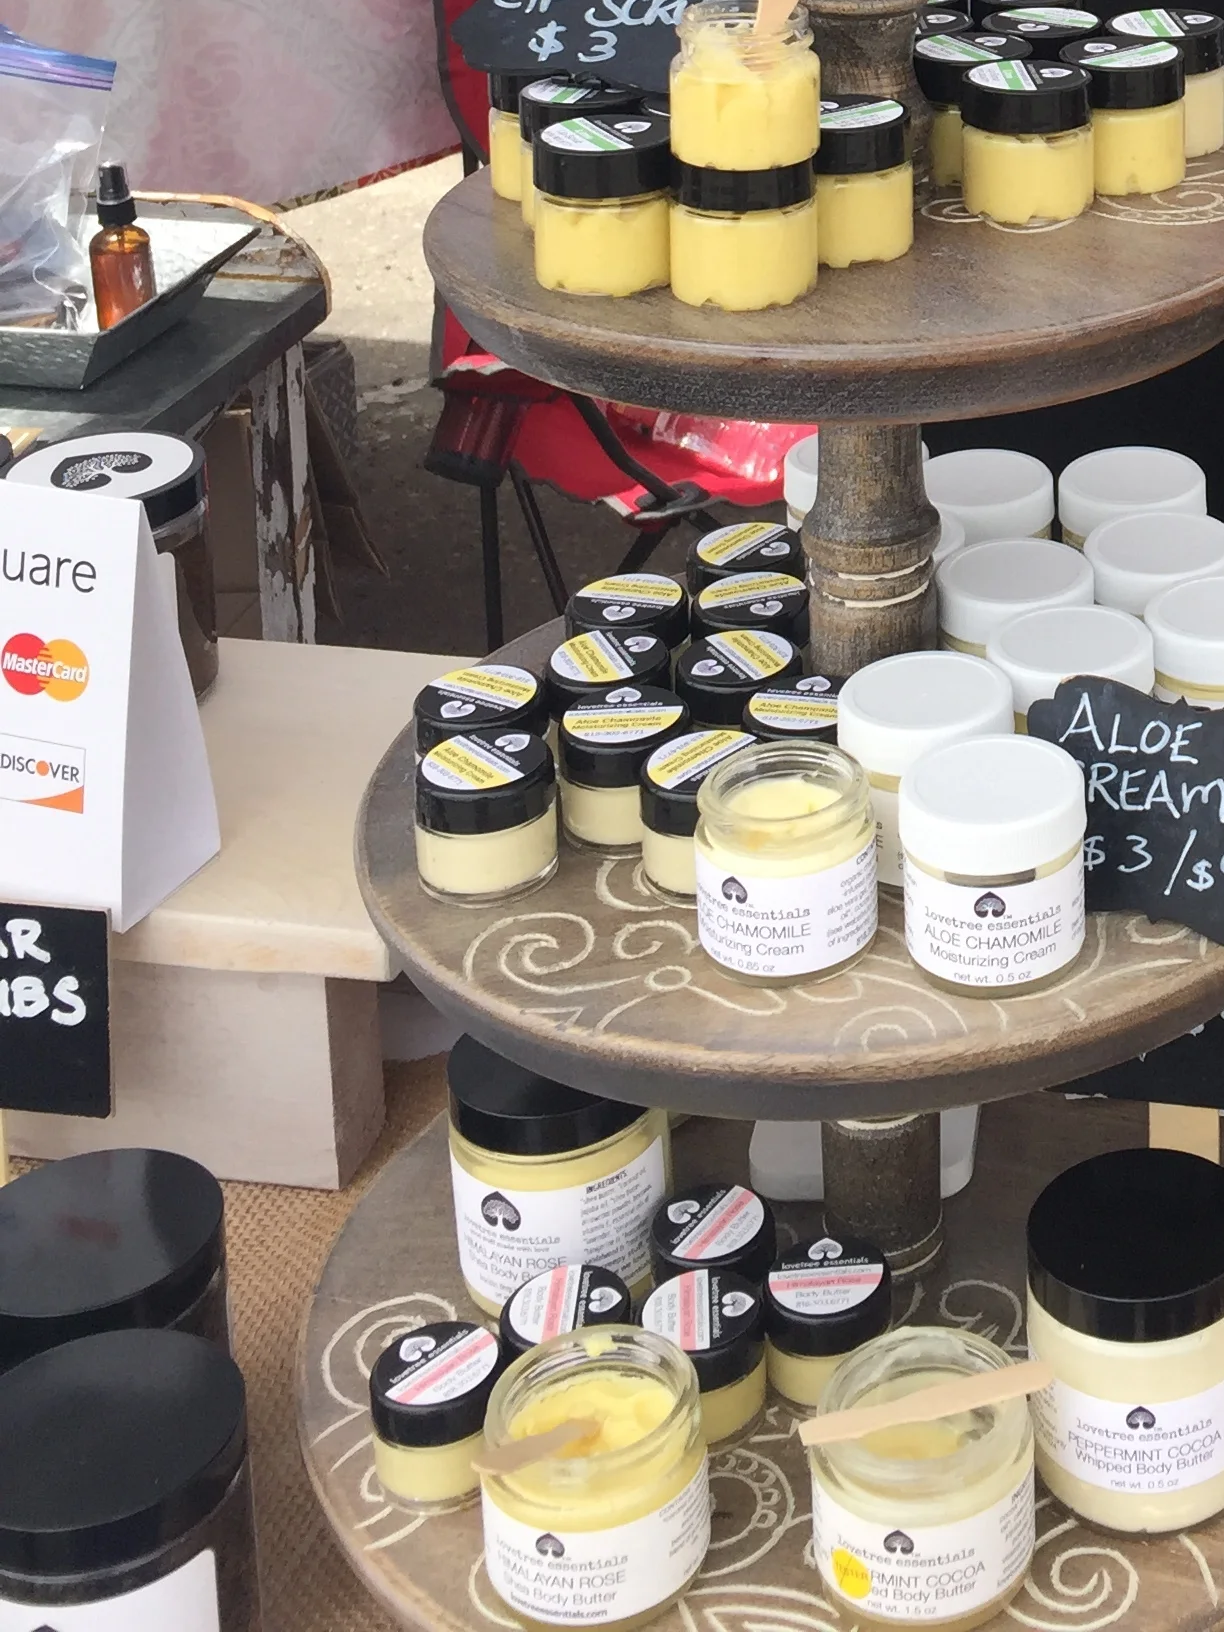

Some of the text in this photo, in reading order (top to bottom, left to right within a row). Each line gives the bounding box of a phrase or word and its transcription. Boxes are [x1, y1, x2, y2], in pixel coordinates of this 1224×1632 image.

[2, 652, 87, 683] MasterCard
[1059, 692, 1203, 764] ALOE
[732, 908, 811, 921] essentials
[925, 904, 1062, 931] lovetree essentials
[717, 915, 811, 940] CHAMOMILE
[924, 919, 1062, 950] ALOE CHAMOMILE
[756, 944, 805, 957] Cream
[930, 941, 1057, 969] Moisturizing Cream
[1076, 1417, 1213, 1442] lovetree essentials
[1068, 1430, 1222, 1462] PEPPERMINT COCOA
[1075, 1447, 1215, 1476] Whipped Body Butter
[547, 1554, 629, 1573] essentials
[895, 1547, 975, 1568] essentials
[579, 1570, 627, 1590] ROSE
[925, 1560, 986, 1588] COCOA
[533, 1587, 569, 1607] Body
[572, 1590, 618, 1606] Butter
[892, 1587, 930, 1604] Body
[935, 1580, 977, 1601] Butter
